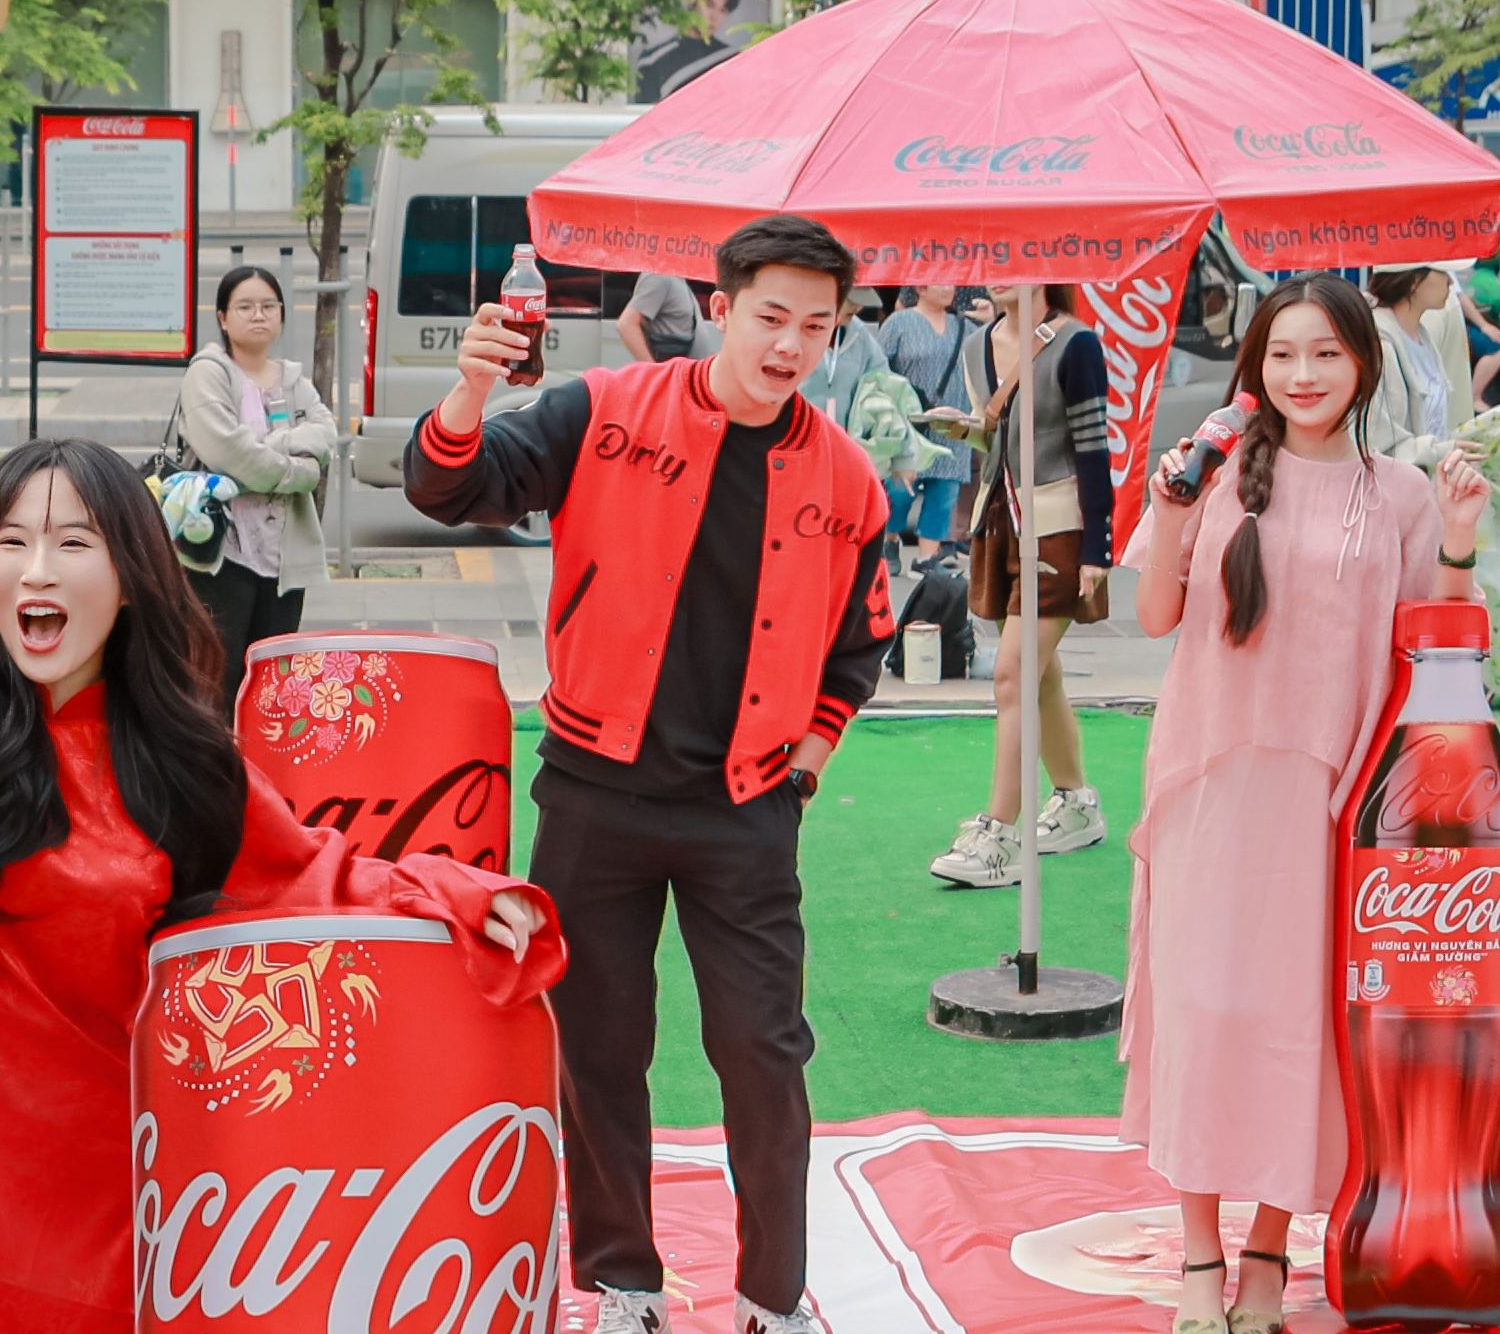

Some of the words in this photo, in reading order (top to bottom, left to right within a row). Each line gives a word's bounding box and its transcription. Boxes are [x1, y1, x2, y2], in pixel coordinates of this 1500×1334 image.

[893, 135, 1100, 175] Coca-Cola
[1232, 123, 1380, 160] Coca-Cola
[918, 177, 980, 189] ZERO
[546, 217, 598, 246] Ngon
[602, 221, 659, 255] không
[664, 232, 722, 258] cưỡn
[908, 234, 1009, 266] không
[1021, 232, 1122, 264] cưỡng
[1243, 226, 1301, 255] Ngon
[1308, 219, 1380, 245] không
[1386, 212, 1456, 242] cưỡng
[1371, 939, 1411, 952] HƯƠNG
[1414, 942, 1427, 952] VỊ
[1430, 938, 1483, 951] NGUYÊN
[1397, 951, 1430, 963] GIẢM
